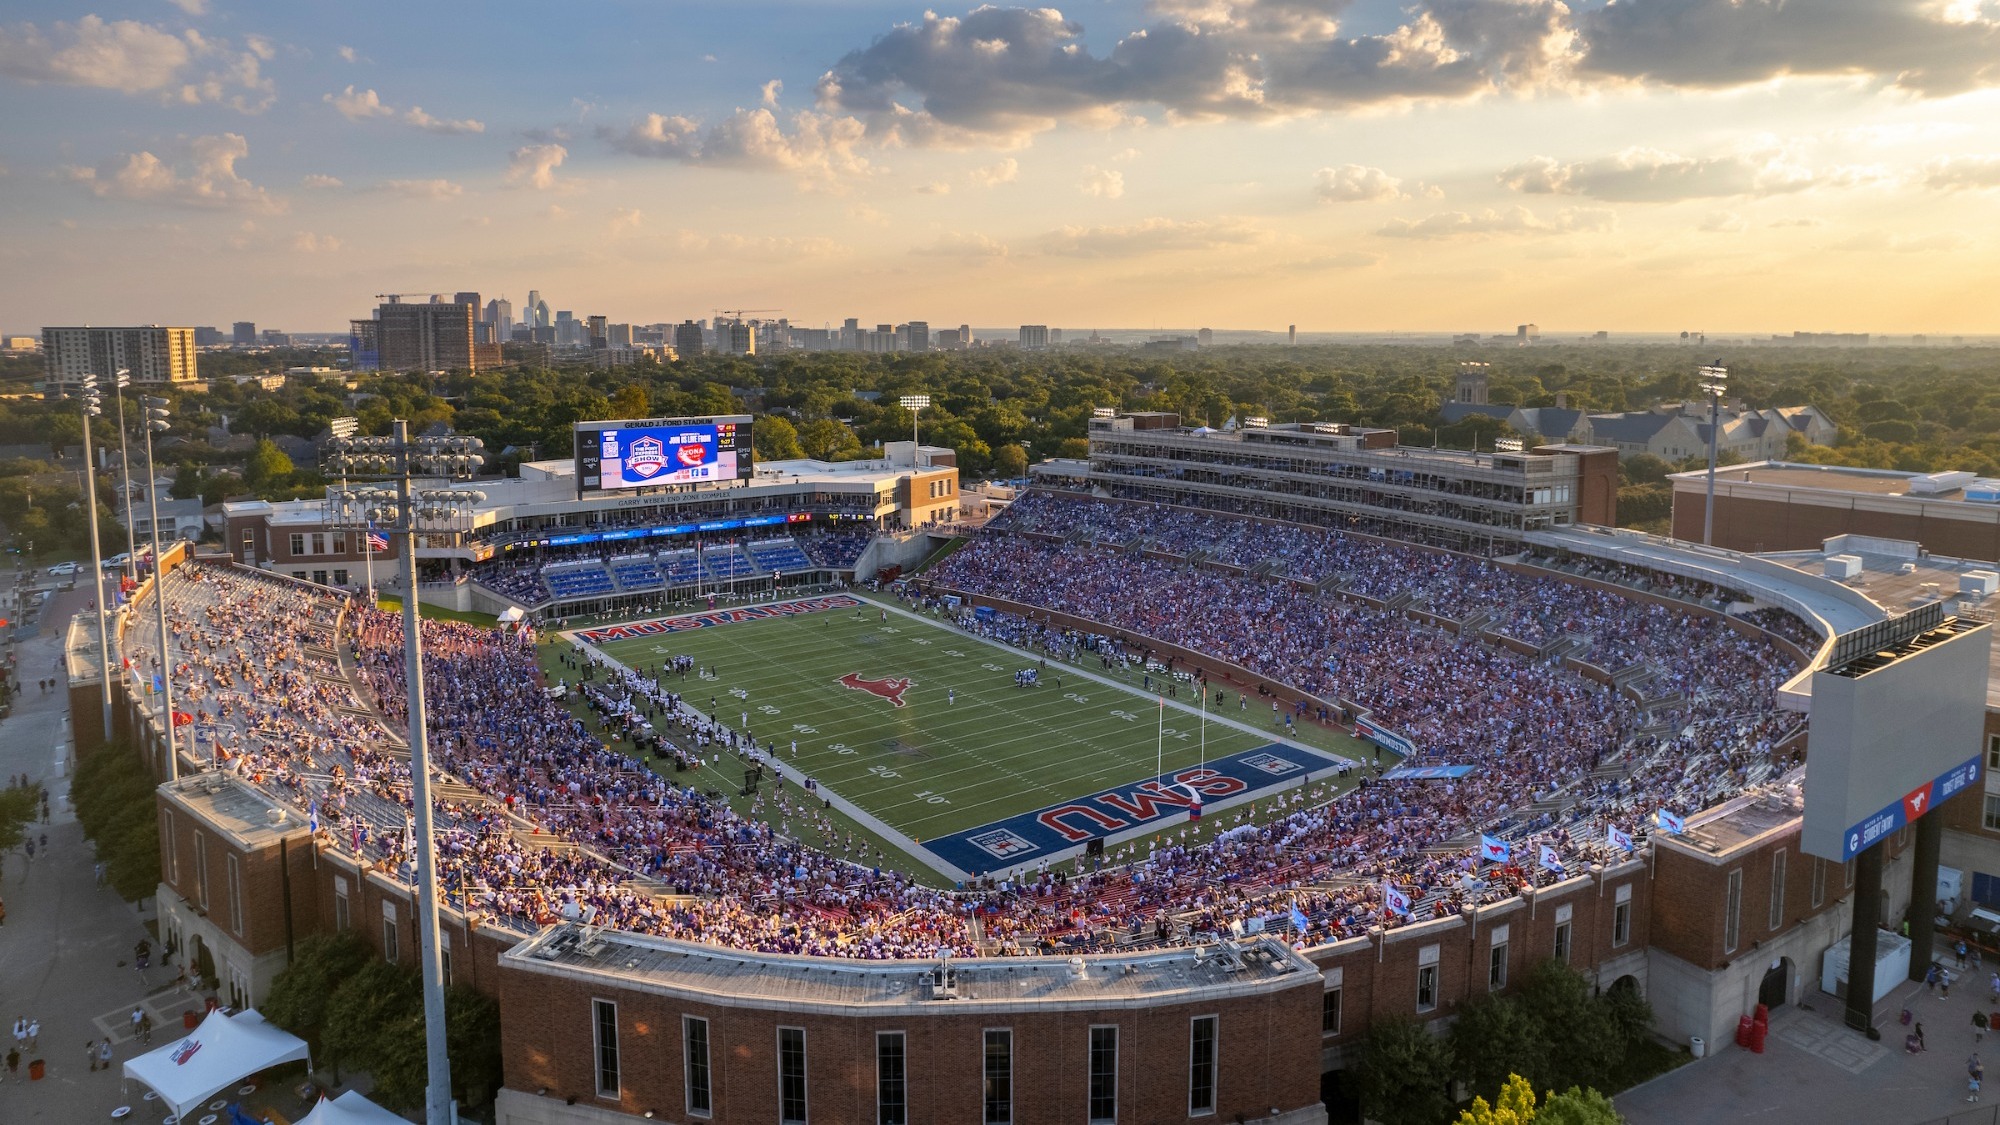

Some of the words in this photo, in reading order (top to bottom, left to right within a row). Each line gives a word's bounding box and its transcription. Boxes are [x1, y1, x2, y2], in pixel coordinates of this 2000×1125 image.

[702, 491, 731, 499] COMPLEX
[580, 596, 859, 643] MUSTANGS
[758, 705, 781, 715] 50
[828, 743, 854, 754] 30
[868, 766, 898, 778] 20
[914, 790, 945, 804] 10
[1037, 769, 1247, 842] SMU
[1863, 821, 1881, 844] STUDENT
[1881, 814, 1894, 834] ENTRY
[1389, 894, 1403, 908] 19
